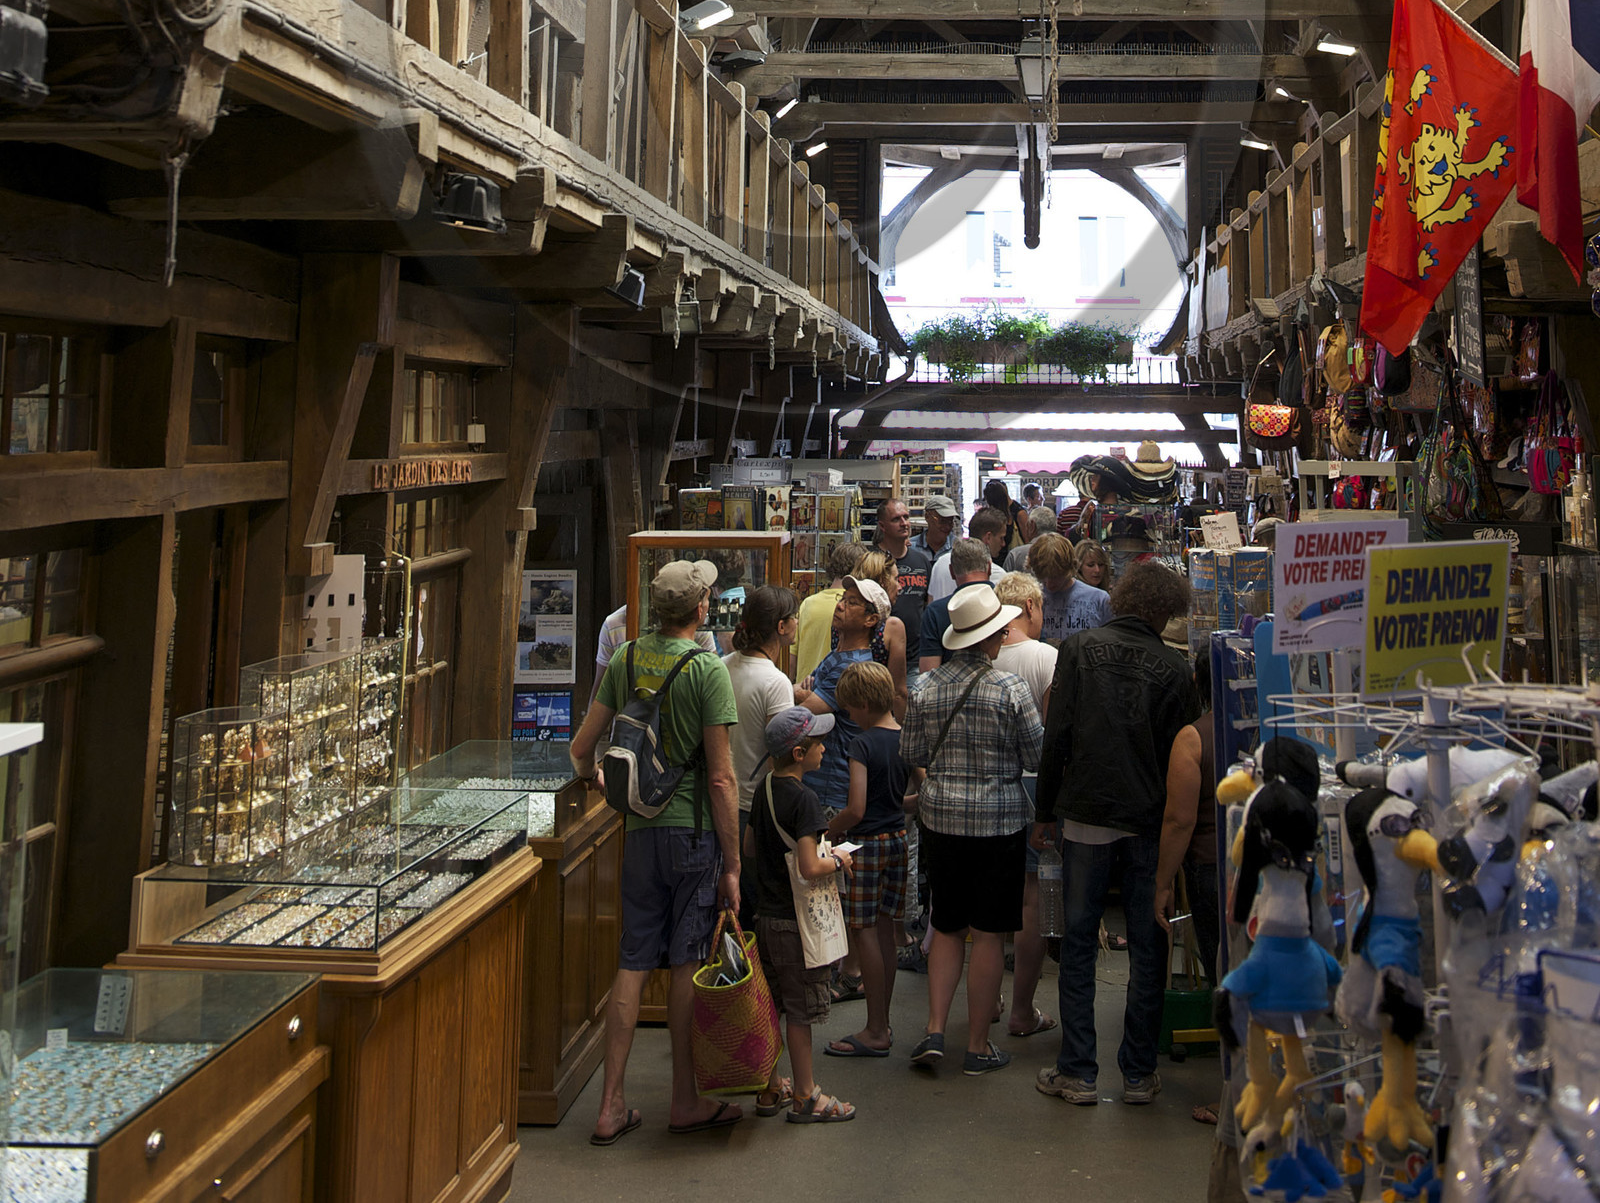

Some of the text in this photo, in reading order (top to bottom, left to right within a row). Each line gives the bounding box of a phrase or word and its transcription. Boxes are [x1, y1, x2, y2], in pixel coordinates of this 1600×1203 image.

[374, 459, 472, 488] LE JARDIN DES ARTS
[1294, 530, 1387, 558] DEMANDEZ
[898, 575, 927, 587] STAGE
[1283, 559, 1365, 586] VOTRE PRE
[1386, 563, 1492, 605] DEMANDEZ
[1067, 615, 1090, 629] Jeans
[1374, 607, 1499, 652] VOTRE PRENOM
